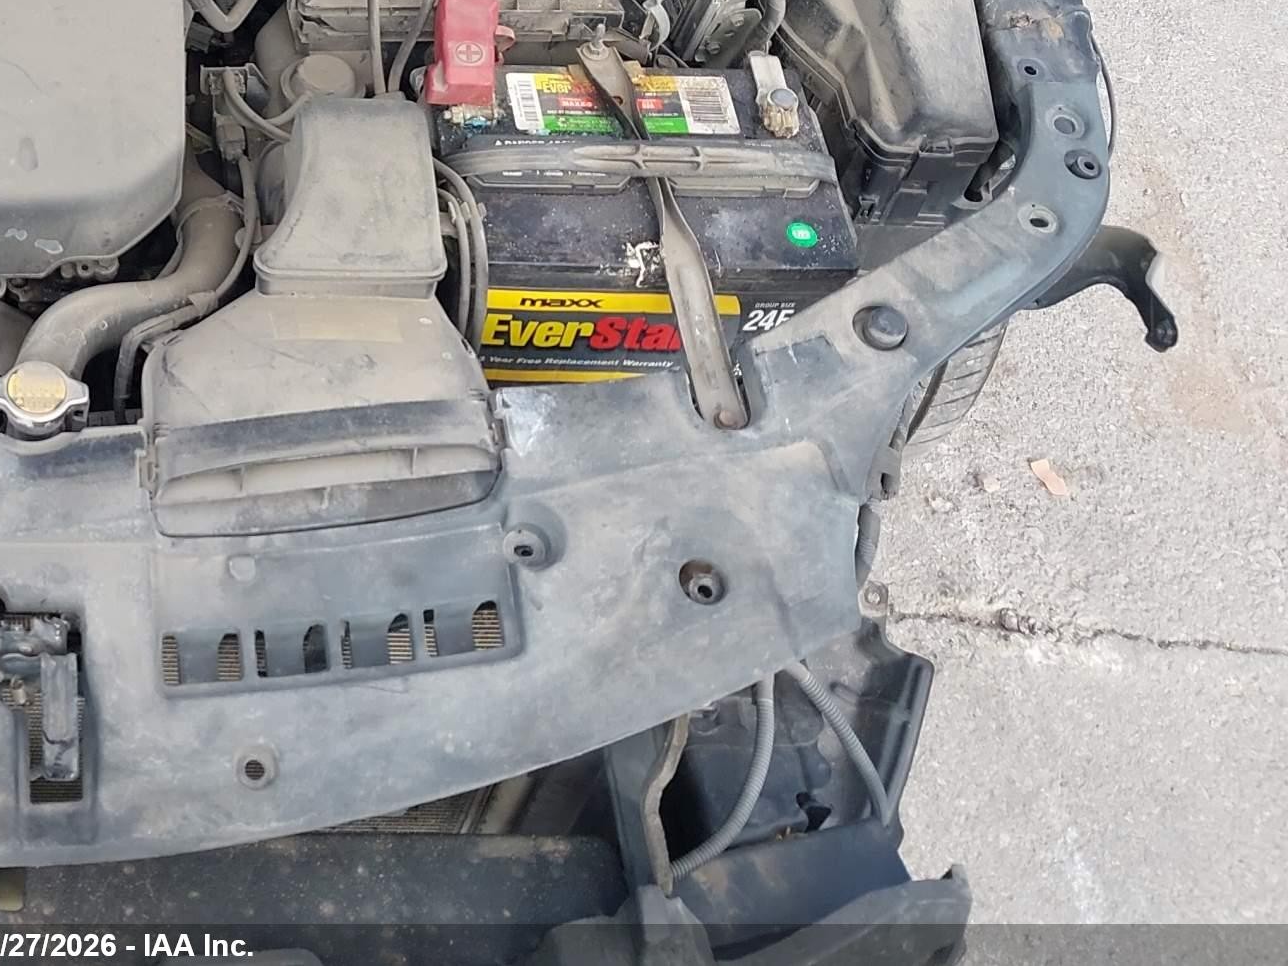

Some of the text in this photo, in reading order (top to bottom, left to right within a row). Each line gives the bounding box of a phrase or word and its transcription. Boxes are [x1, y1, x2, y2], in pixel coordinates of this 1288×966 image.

[519, 296, 604, 309] maxx
[489, 356, 513, 364] Year
[516, 357, 542, 365] Free
[544, 357, 619, 367] Replacement
[622, 359, 674, 368] Warranty
